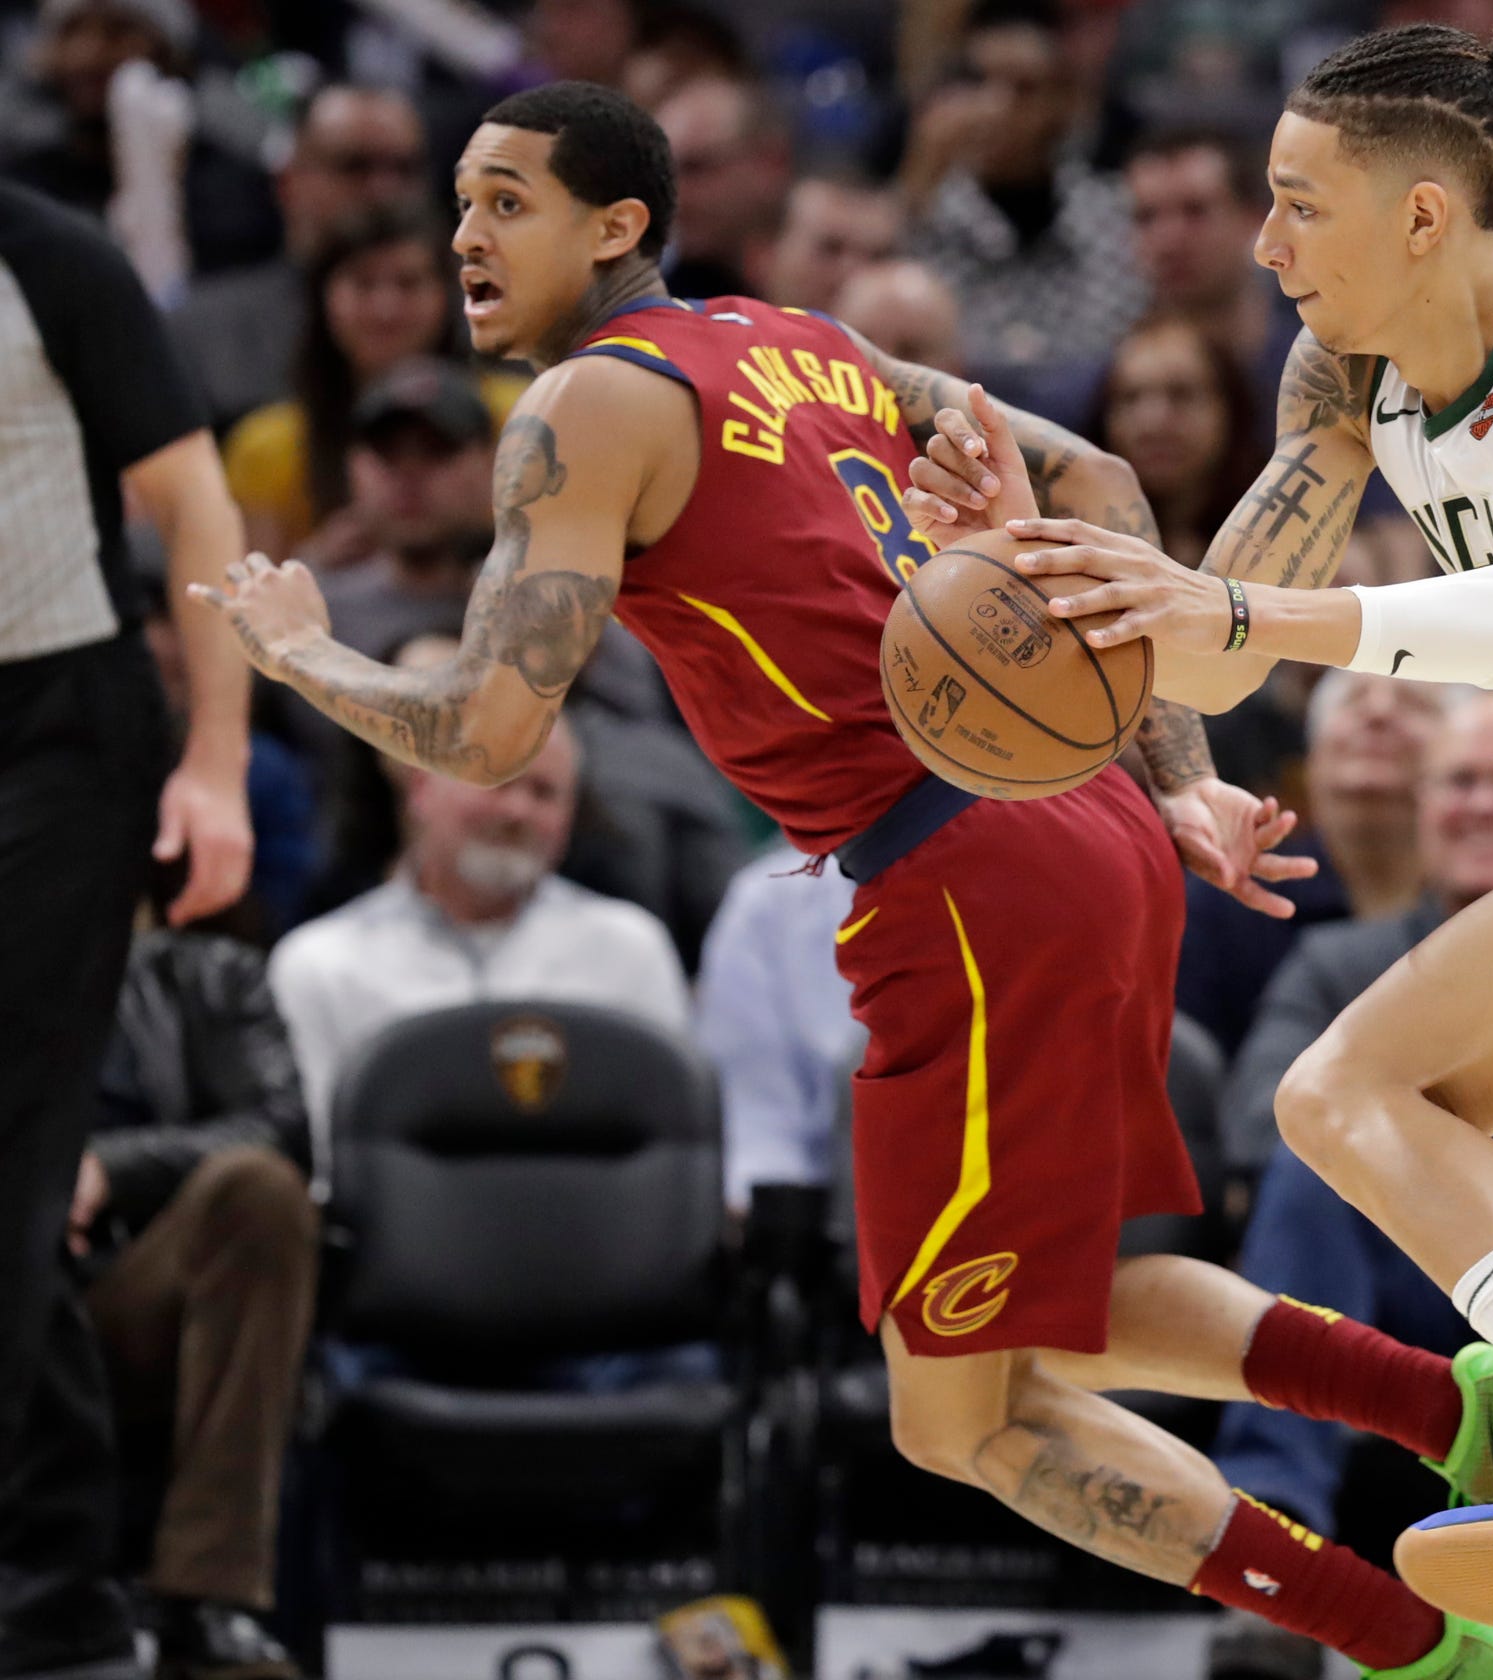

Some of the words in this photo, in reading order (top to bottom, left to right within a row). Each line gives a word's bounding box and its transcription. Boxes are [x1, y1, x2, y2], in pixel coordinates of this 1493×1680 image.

[722, 345, 899, 465] CLARKSON
[829, 447, 938, 591] 8
[1230, 625, 1246, 652] ings
